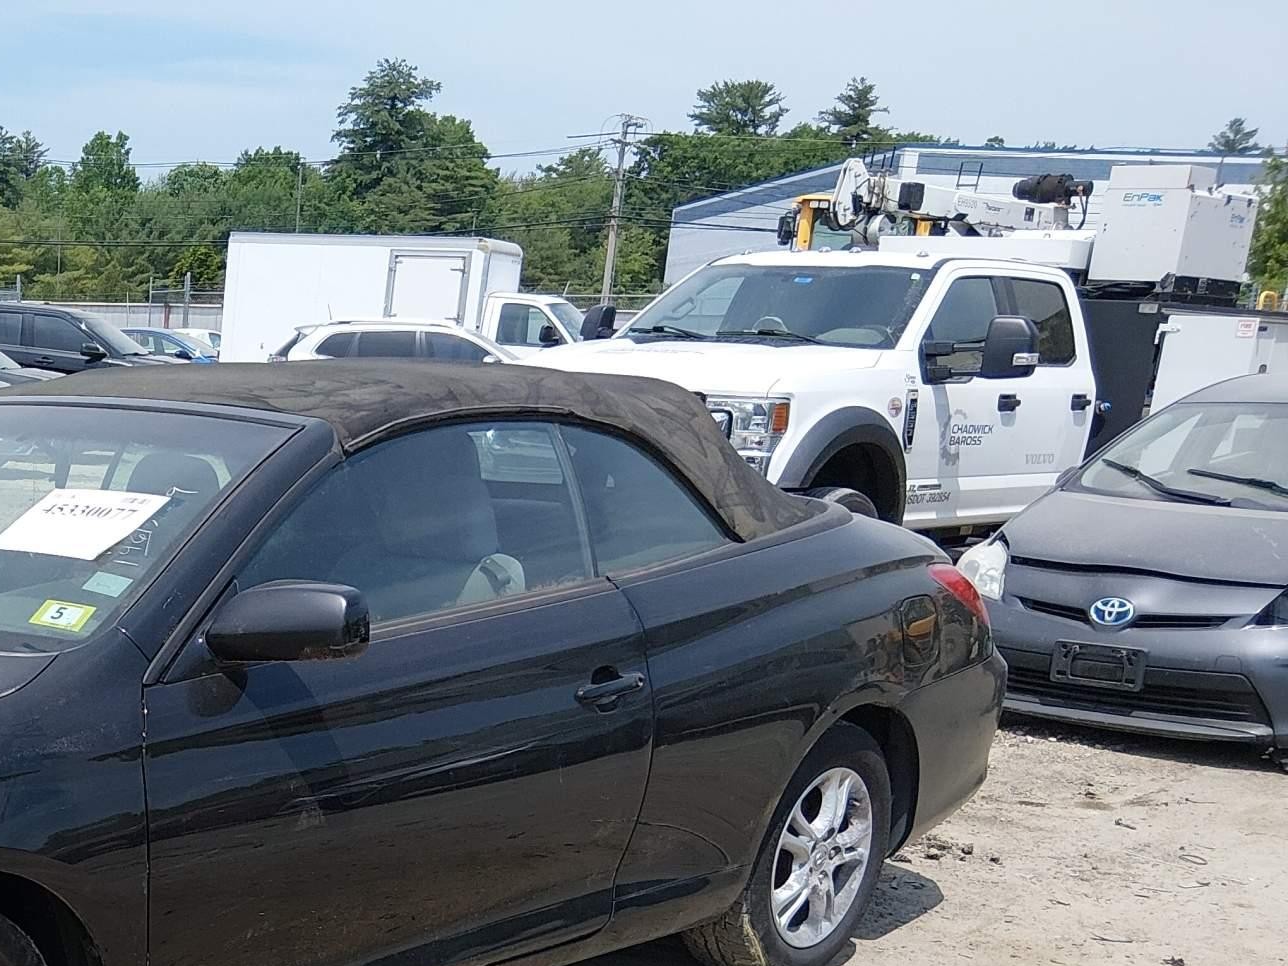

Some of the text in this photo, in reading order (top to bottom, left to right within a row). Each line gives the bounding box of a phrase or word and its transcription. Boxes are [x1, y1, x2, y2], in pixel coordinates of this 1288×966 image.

[1123, 192, 1164, 202] EnPak
[951, 424, 994, 435] CHADWICK
[949, 436, 982, 446] BAROSS
[1025, 453, 1055, 465] VOLVO
[42, 503, 139, 520] 45330077
[50, 607, 68, 620] 5
